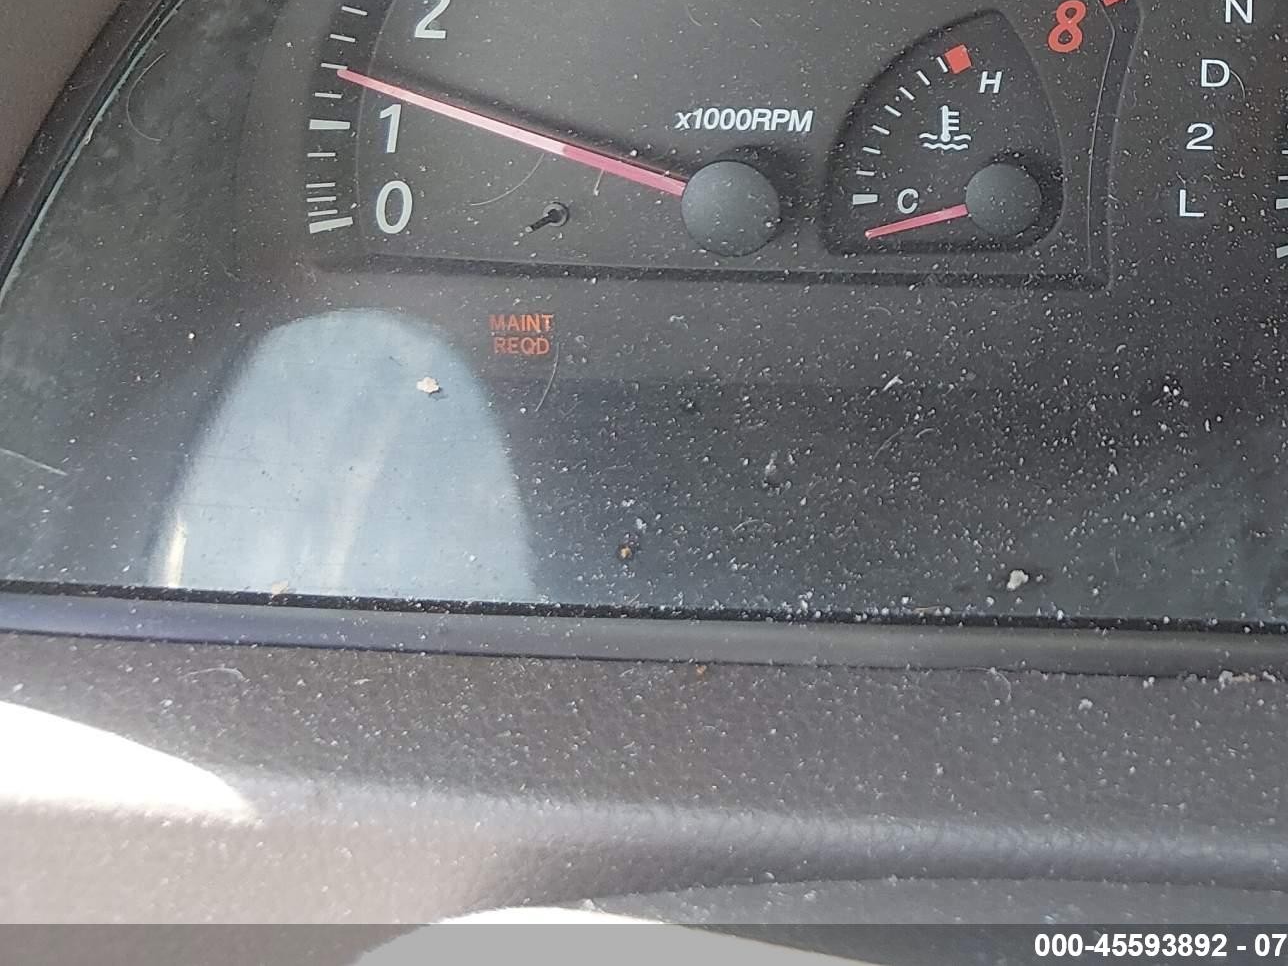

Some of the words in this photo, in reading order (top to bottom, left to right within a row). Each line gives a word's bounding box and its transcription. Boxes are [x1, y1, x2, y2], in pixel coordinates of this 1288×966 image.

[1047, 0, 1087, 54] 8
[979, 71, 1002, 94] H
[1201, 59, 1230, 88] D
[379, 103, 402, 153] 1
[674, 108, 814, 133] x1000RPM
[1186, 123, 1214, 150] 2
[376, 180, 413, 234] 0
[897, 188, 919, 212] C
[1179, 190, 1204, 216] L
[490, 314, 554, 331] MAINT
[494, 337, 550, 354] REQD
